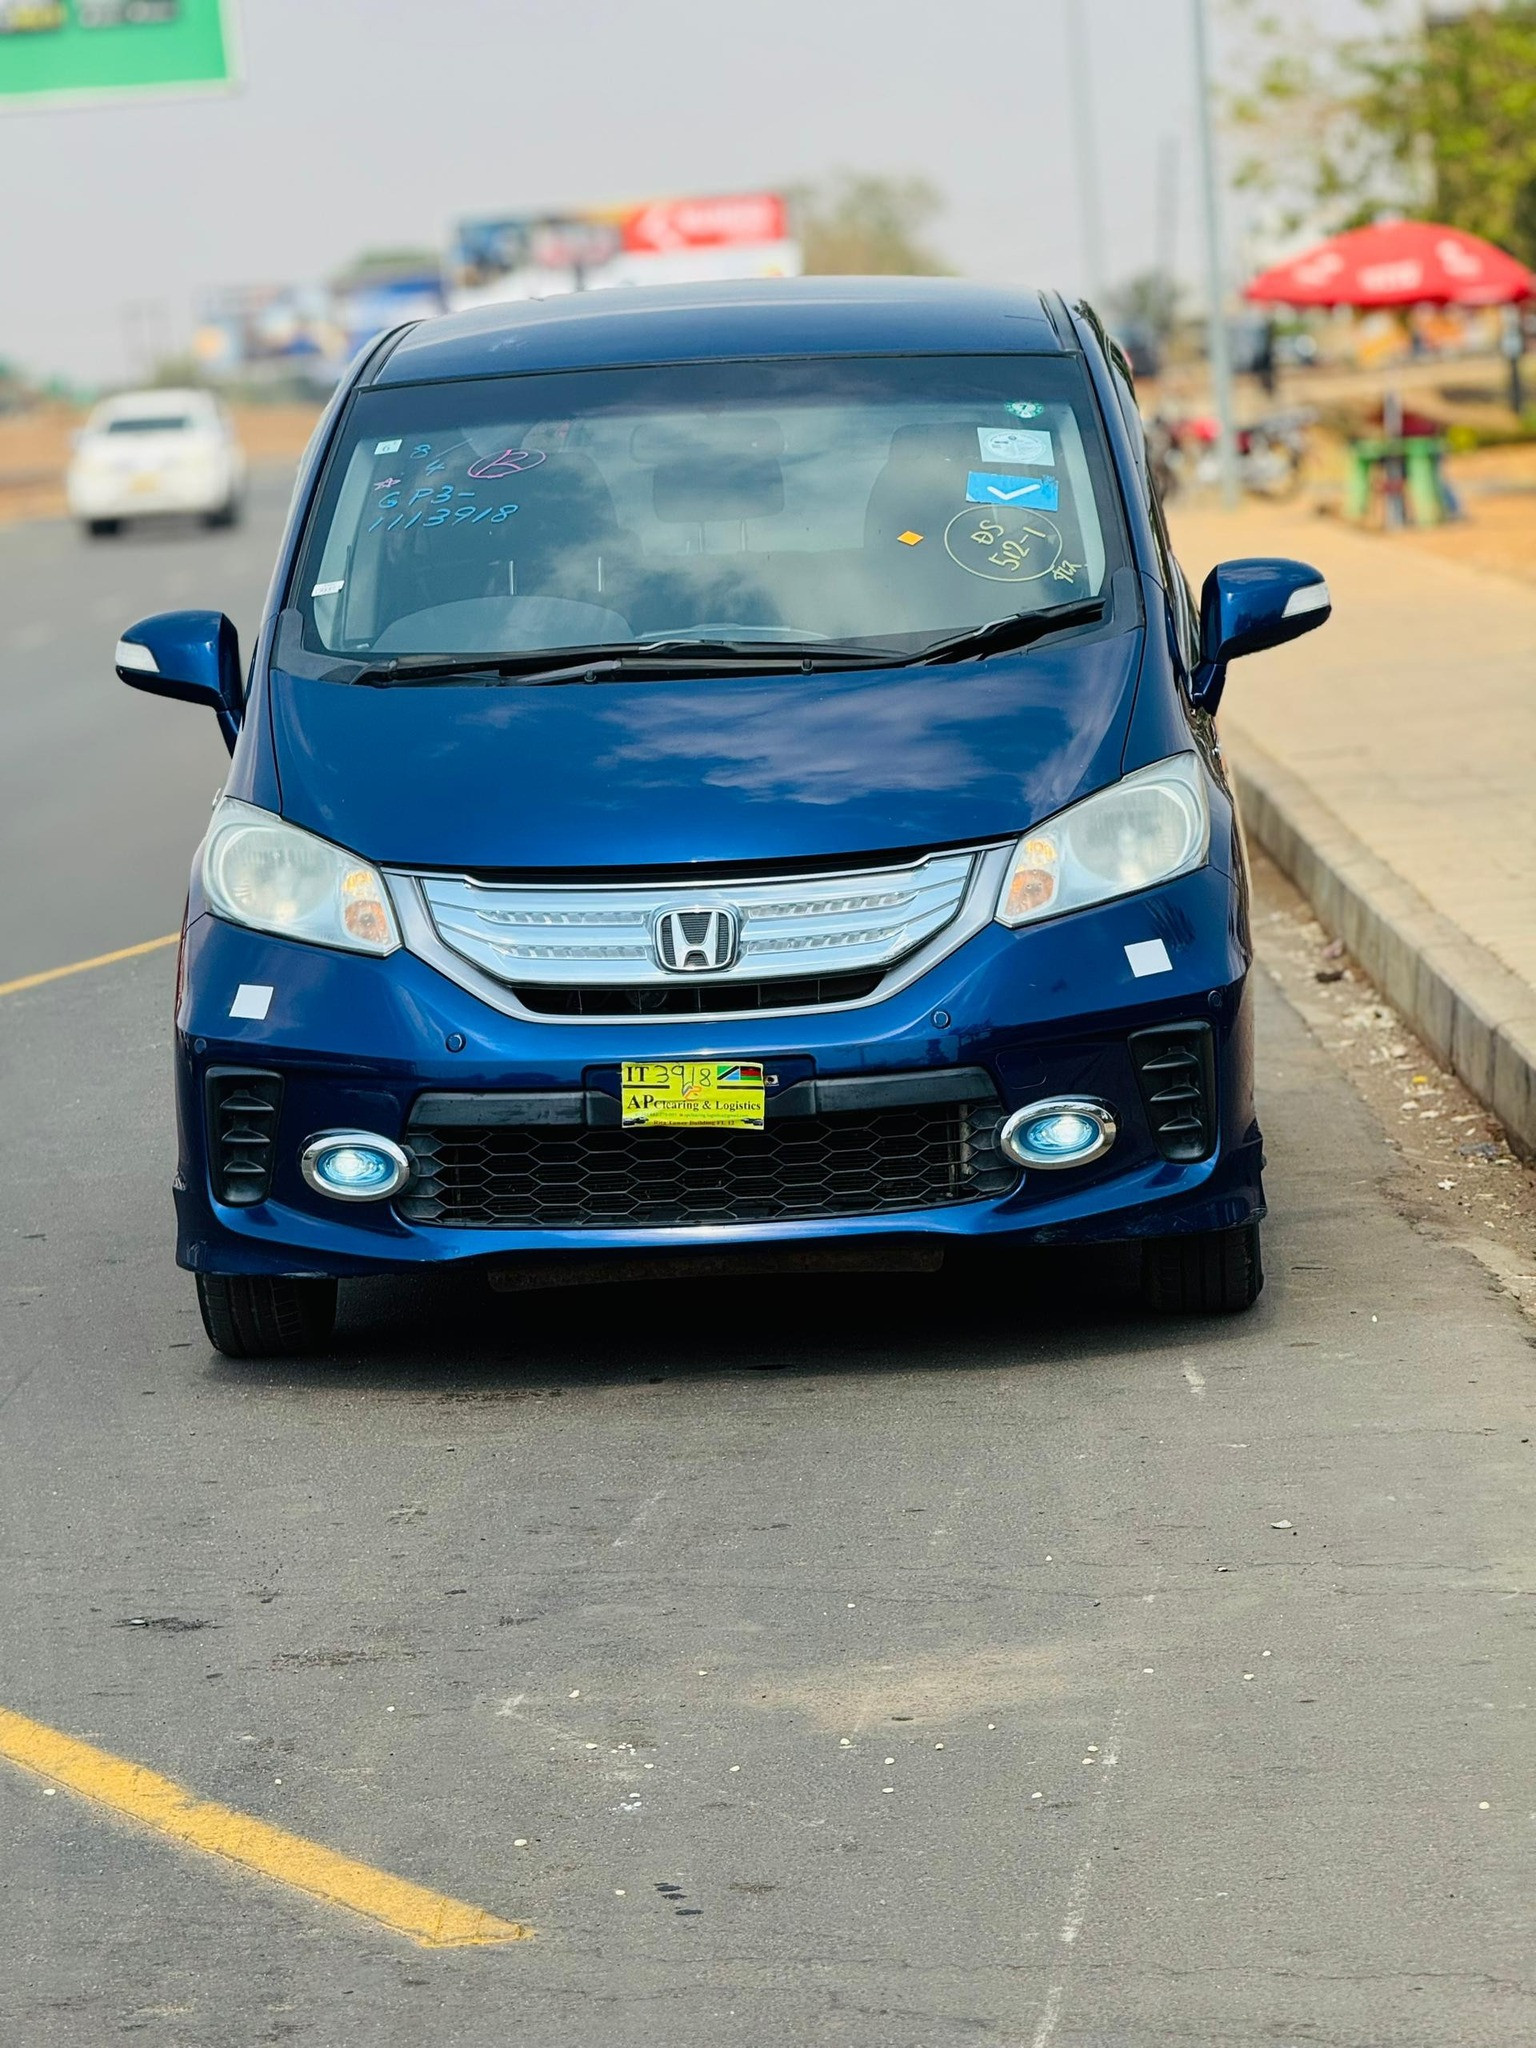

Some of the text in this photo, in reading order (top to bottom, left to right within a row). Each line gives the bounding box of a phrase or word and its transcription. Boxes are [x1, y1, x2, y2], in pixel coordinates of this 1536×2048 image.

[368, 504, 519, 533] 1113918
[627, 1066, 649, 1082] IT
[702, 1101, 711, 1110] &
[716, 1101, 761, 1112] Logistics
